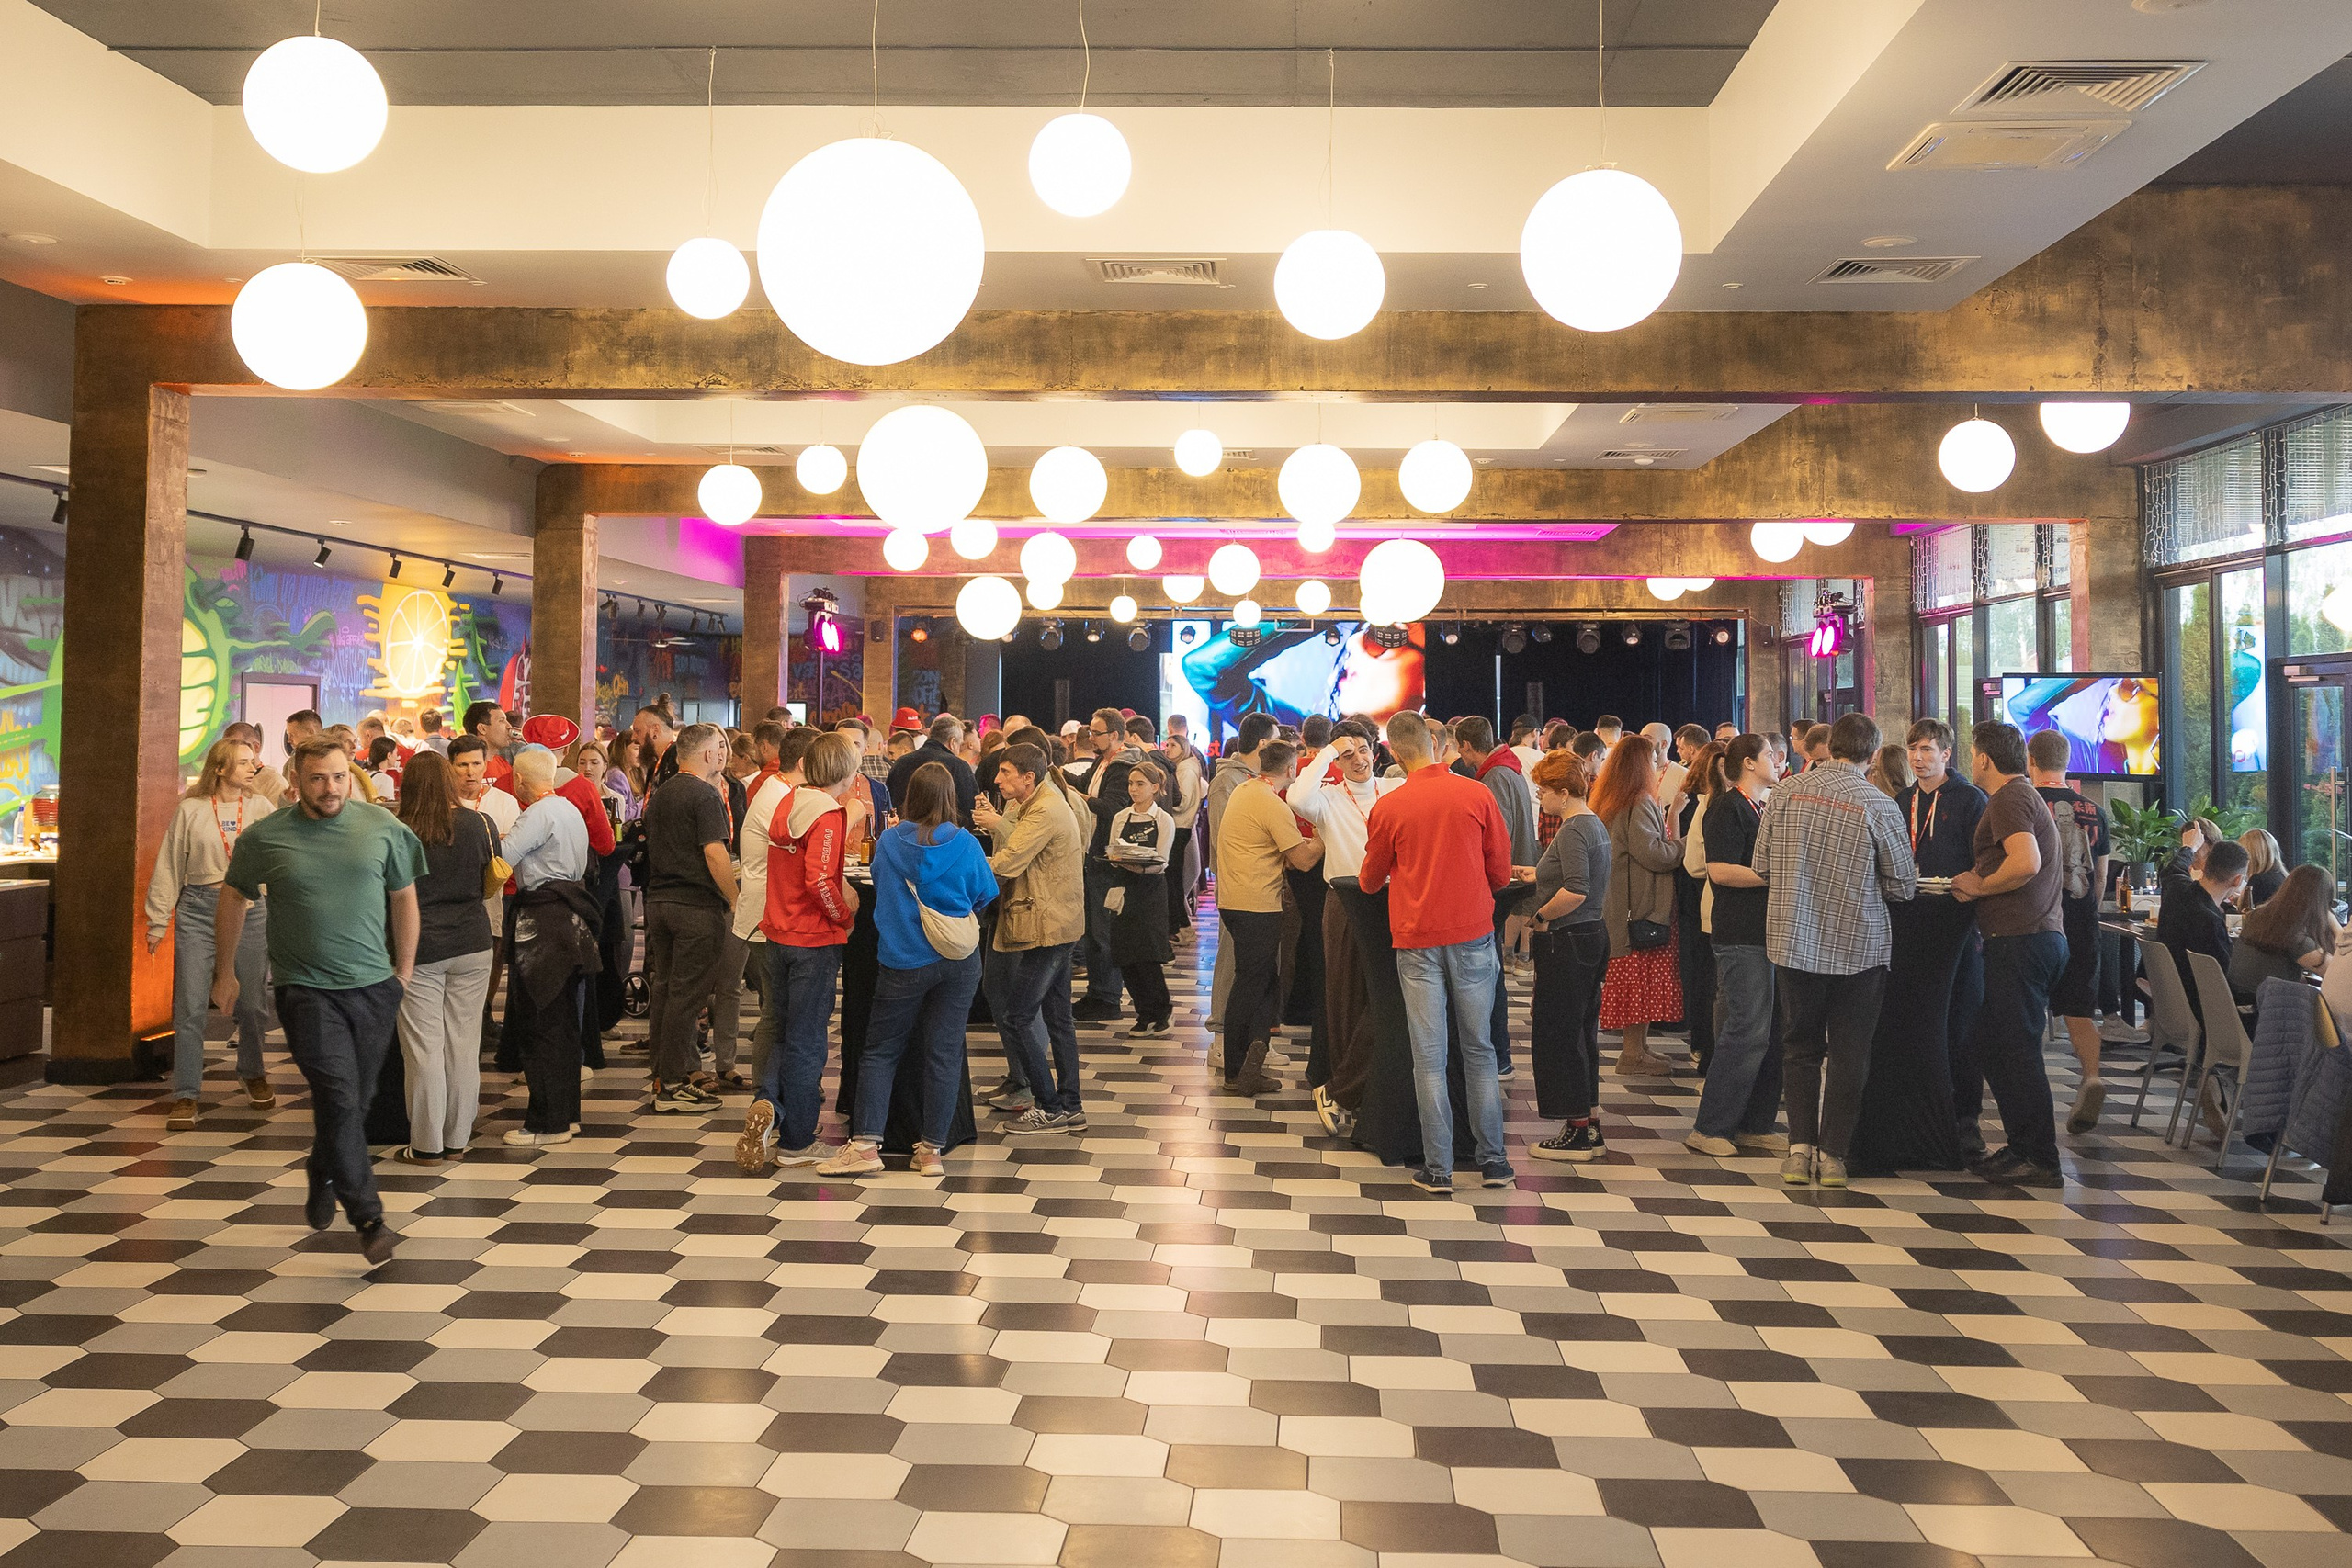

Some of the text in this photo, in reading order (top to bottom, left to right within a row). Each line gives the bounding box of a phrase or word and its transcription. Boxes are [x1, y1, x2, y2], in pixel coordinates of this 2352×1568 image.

[1205, 739, 1221, 757] st
[820, 829, 833, 863] СИЛА!
[1028, 1115, 1046, 1129] N
